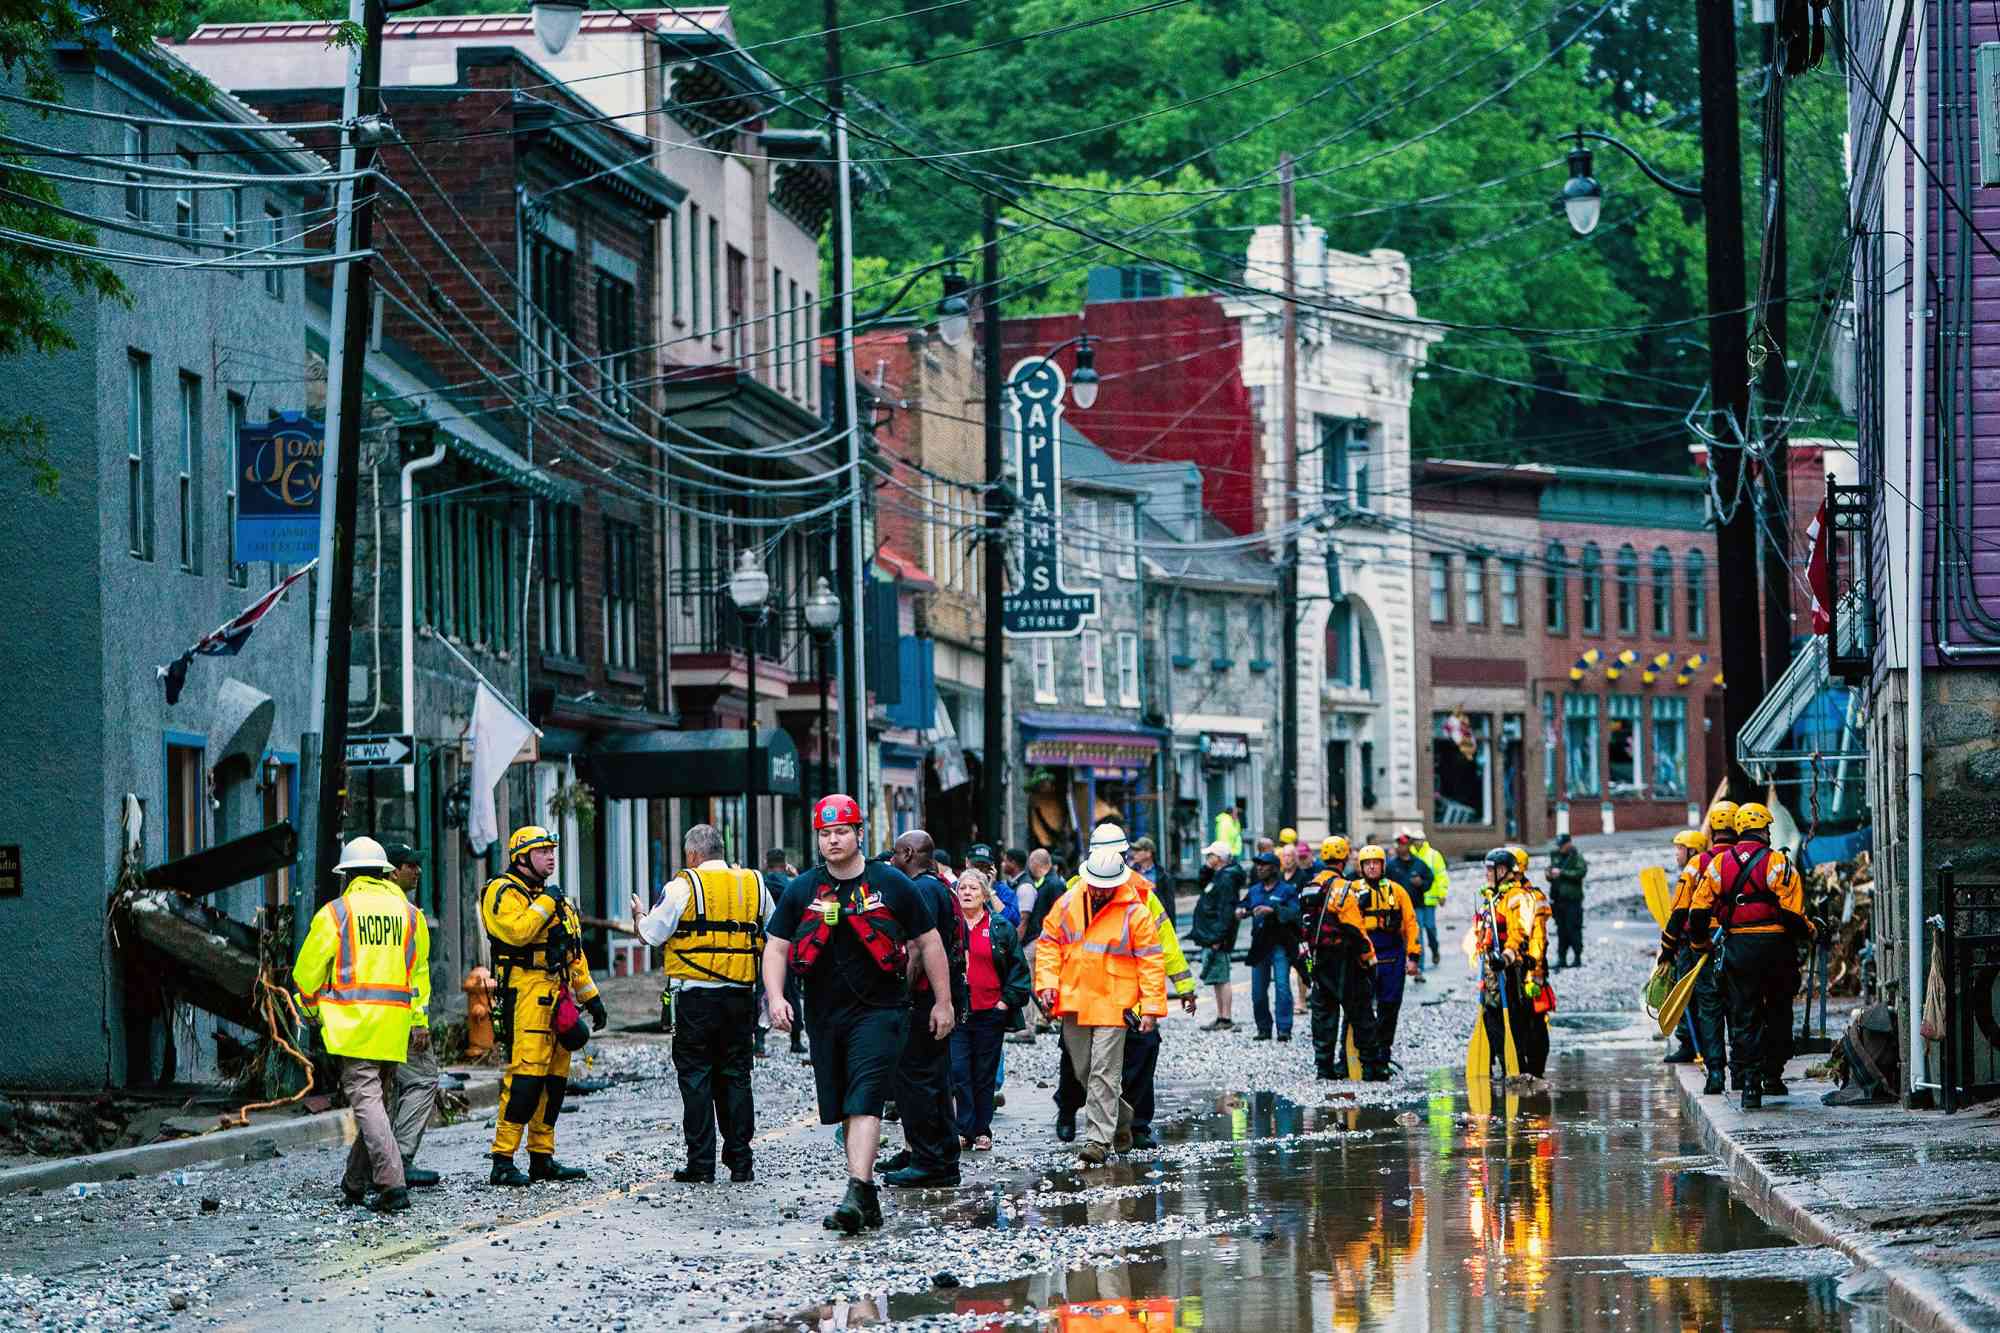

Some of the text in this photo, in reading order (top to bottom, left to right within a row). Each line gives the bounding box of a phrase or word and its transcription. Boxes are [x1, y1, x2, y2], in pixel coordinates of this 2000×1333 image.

[245, 436, 325, 483] JOA
[1021, 369, 1050, 592] CAPLAN'S
[1003, 598, 1090, 612] EPARTMENT
[1017, 615, 1066, 629] STORE
[346, 744, 387, 759] NE WAY
[357, 914, 402, 946] HCDPW
